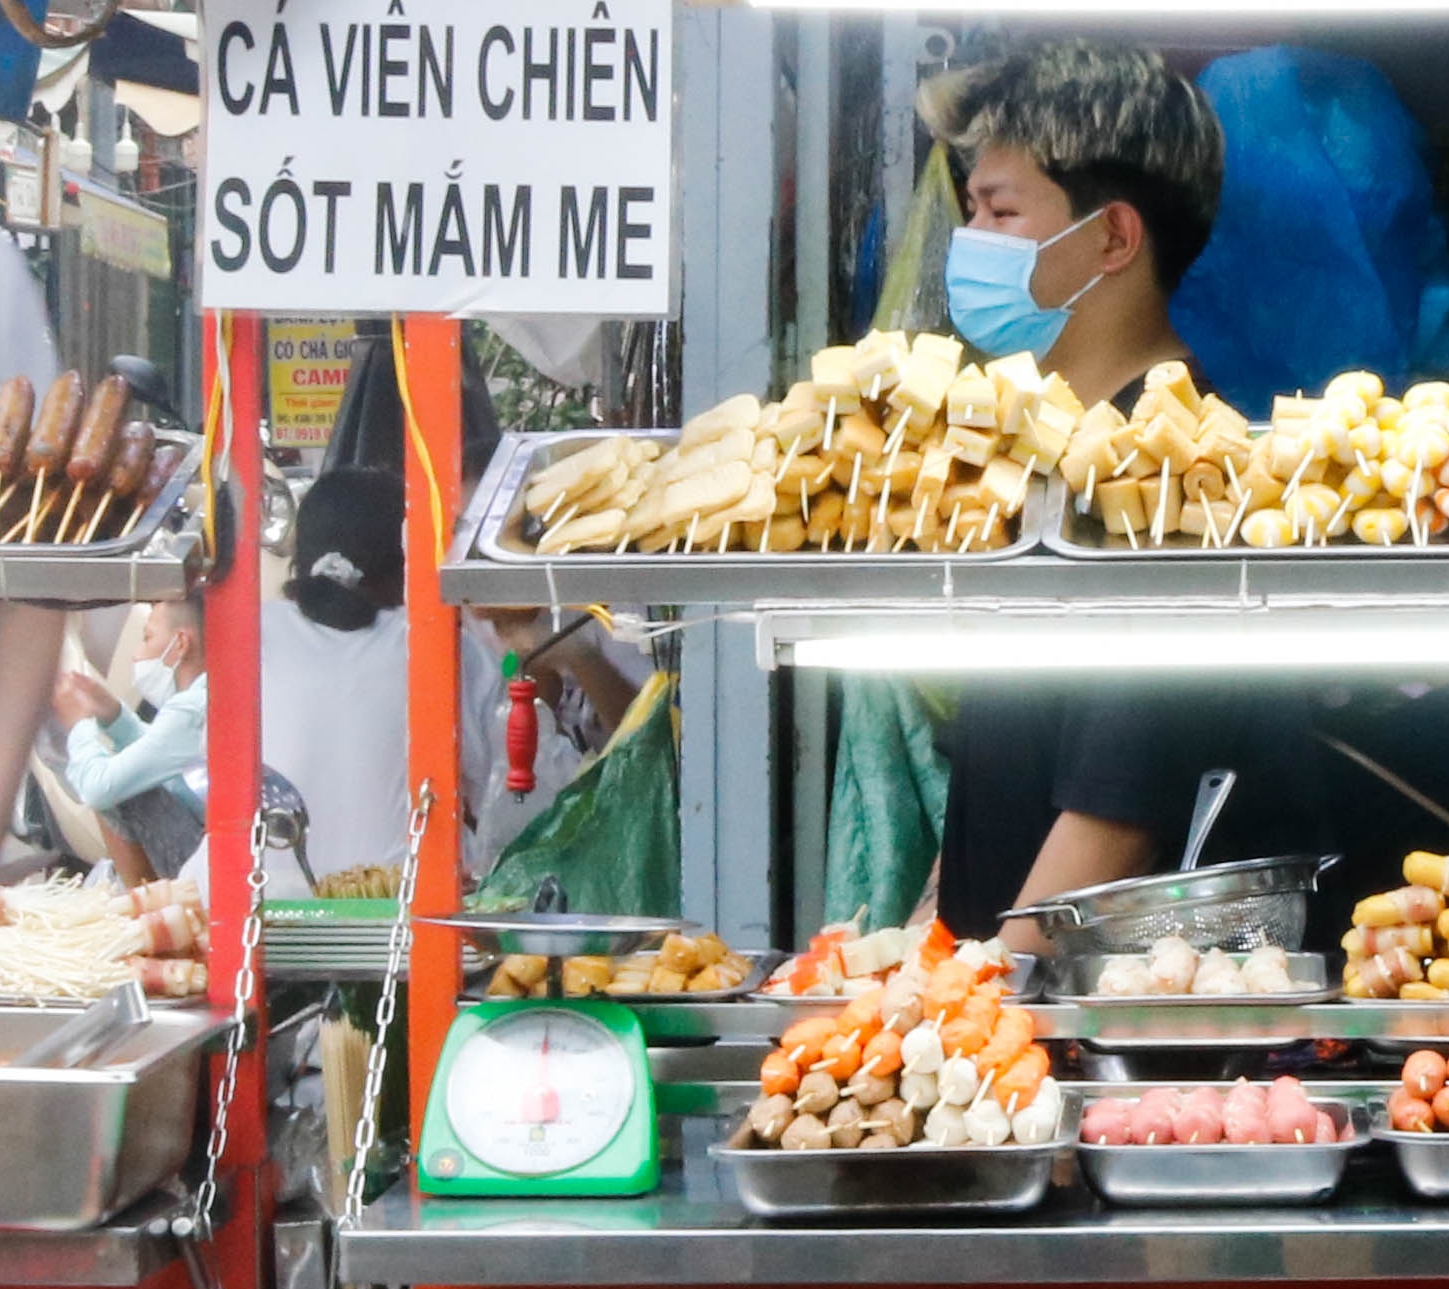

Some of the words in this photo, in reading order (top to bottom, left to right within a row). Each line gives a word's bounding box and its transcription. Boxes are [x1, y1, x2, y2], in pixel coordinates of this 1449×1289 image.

[477, 0, 659, 122] CHIÊN
[210, 155, 352, 275] SỐT
[373, 159, 533, 278] MẮM
[558, 185, 655, 280] ME
